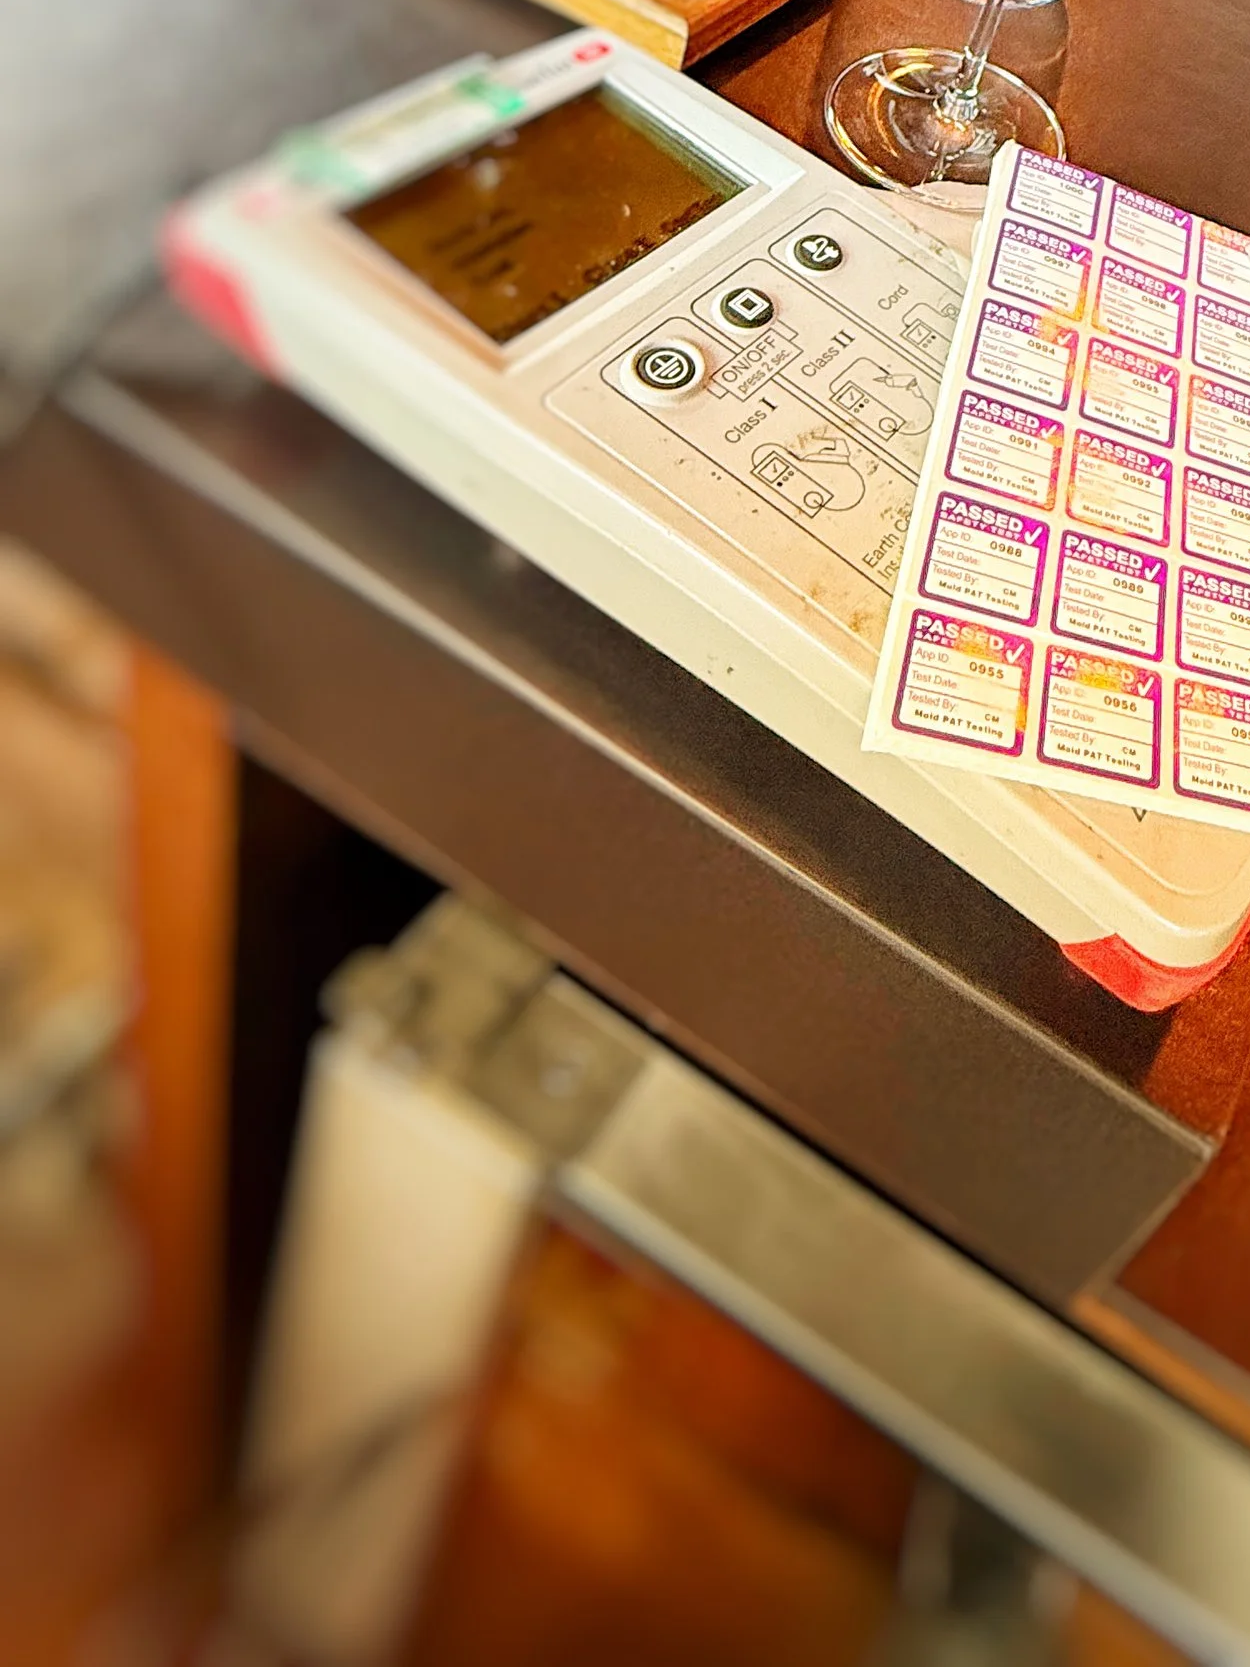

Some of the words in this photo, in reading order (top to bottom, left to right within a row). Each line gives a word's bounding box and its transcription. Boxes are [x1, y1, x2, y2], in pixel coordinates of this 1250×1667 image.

[1022, 151, 1083, 179] PASSED
[1117, 187, 1173, 217] PASSED
[1005, 222, 1070, 251] PASSED
[1104, 260, 1165, 291] PASSED
[878, 284, 909, 310] Cord
[801, 346, 840, 377] Class
[831, 329, 856, 349] II
[1027, 340, 1054, 355] 0994
[1092, 342, 1157, 373] PASSED
[721, 336, 776, 383] ON/OFF
[738, 370, 766, 395] press
[762, 362, 774, 373] 2
[725, 410, 767, 444] Class
[759, 396, 778, 412] I
[964, 395, 1039, 428] PASSED
[964, 420, 980, 431] App
[1009, 435, 1038, 450] 0991
[1079, 434, 1149, 465] PASSED
[987, 474, 1003, 483] PAT
[1006, 480, 1037, 496] Testing
[1022, 476, 1034, 484] CM
[941, 497, 1022, 531] PASSED
[862, 533, 900, 568] Earth
[937, 546, 955, 558] Test
[940, 526, 959, 539] App
[990, 541, 1021, 557] 0988
[1066, 535, 1142, 568] PASSED
[933, 564, 962, 580] Tested
[1066, 564, 1084, 576] App
[1113, 578, 1143, 594] 0989
[964, 588, 982, 598] PAT
[986, 594, 1019, 611] Testing
[1003, 588, 1016, 597] CM
[1065, 583, 1081, 595] Test
[1063, 601, 1090, 616] Tested
[1186, 599, 1202, 611] App
[916, 615, 1004, 650] PASSED
[1129, 624, 1141, 632] CM
[1186, 618, 1201, 630] Test
[1093, 625, 1110, 634] PAT
[1113, 630, 1145, 646] Testing
[915, 647, 935, 661] App
[969, 662, 1003, 679] 0955
[1216, 658, 1231, 667] PAT
[913, 670, 931, 683] Test
[908, 690, 940, 707] Tested
[1053, 683, 1071, 696] App
[1104, 696, 1136, 712] 0956
[984, 714, 999, 723] CM
[1052, 705, 1069, 717] Test
[943, 716, 962, 726] PAT
[966, 721, 1003, 739] Testing
[1050, 725, 1079, 740] Tested
[1122, 747, 1136, 755] CM
[1184, 737, 1200, 749] Test
[1084, 749, 1101, 759] PAT
[1105, 754, 1140, 771] Testing
[1183, 757, 1211, 772] Tested
[1217, 781, 1233, 790] PAT
